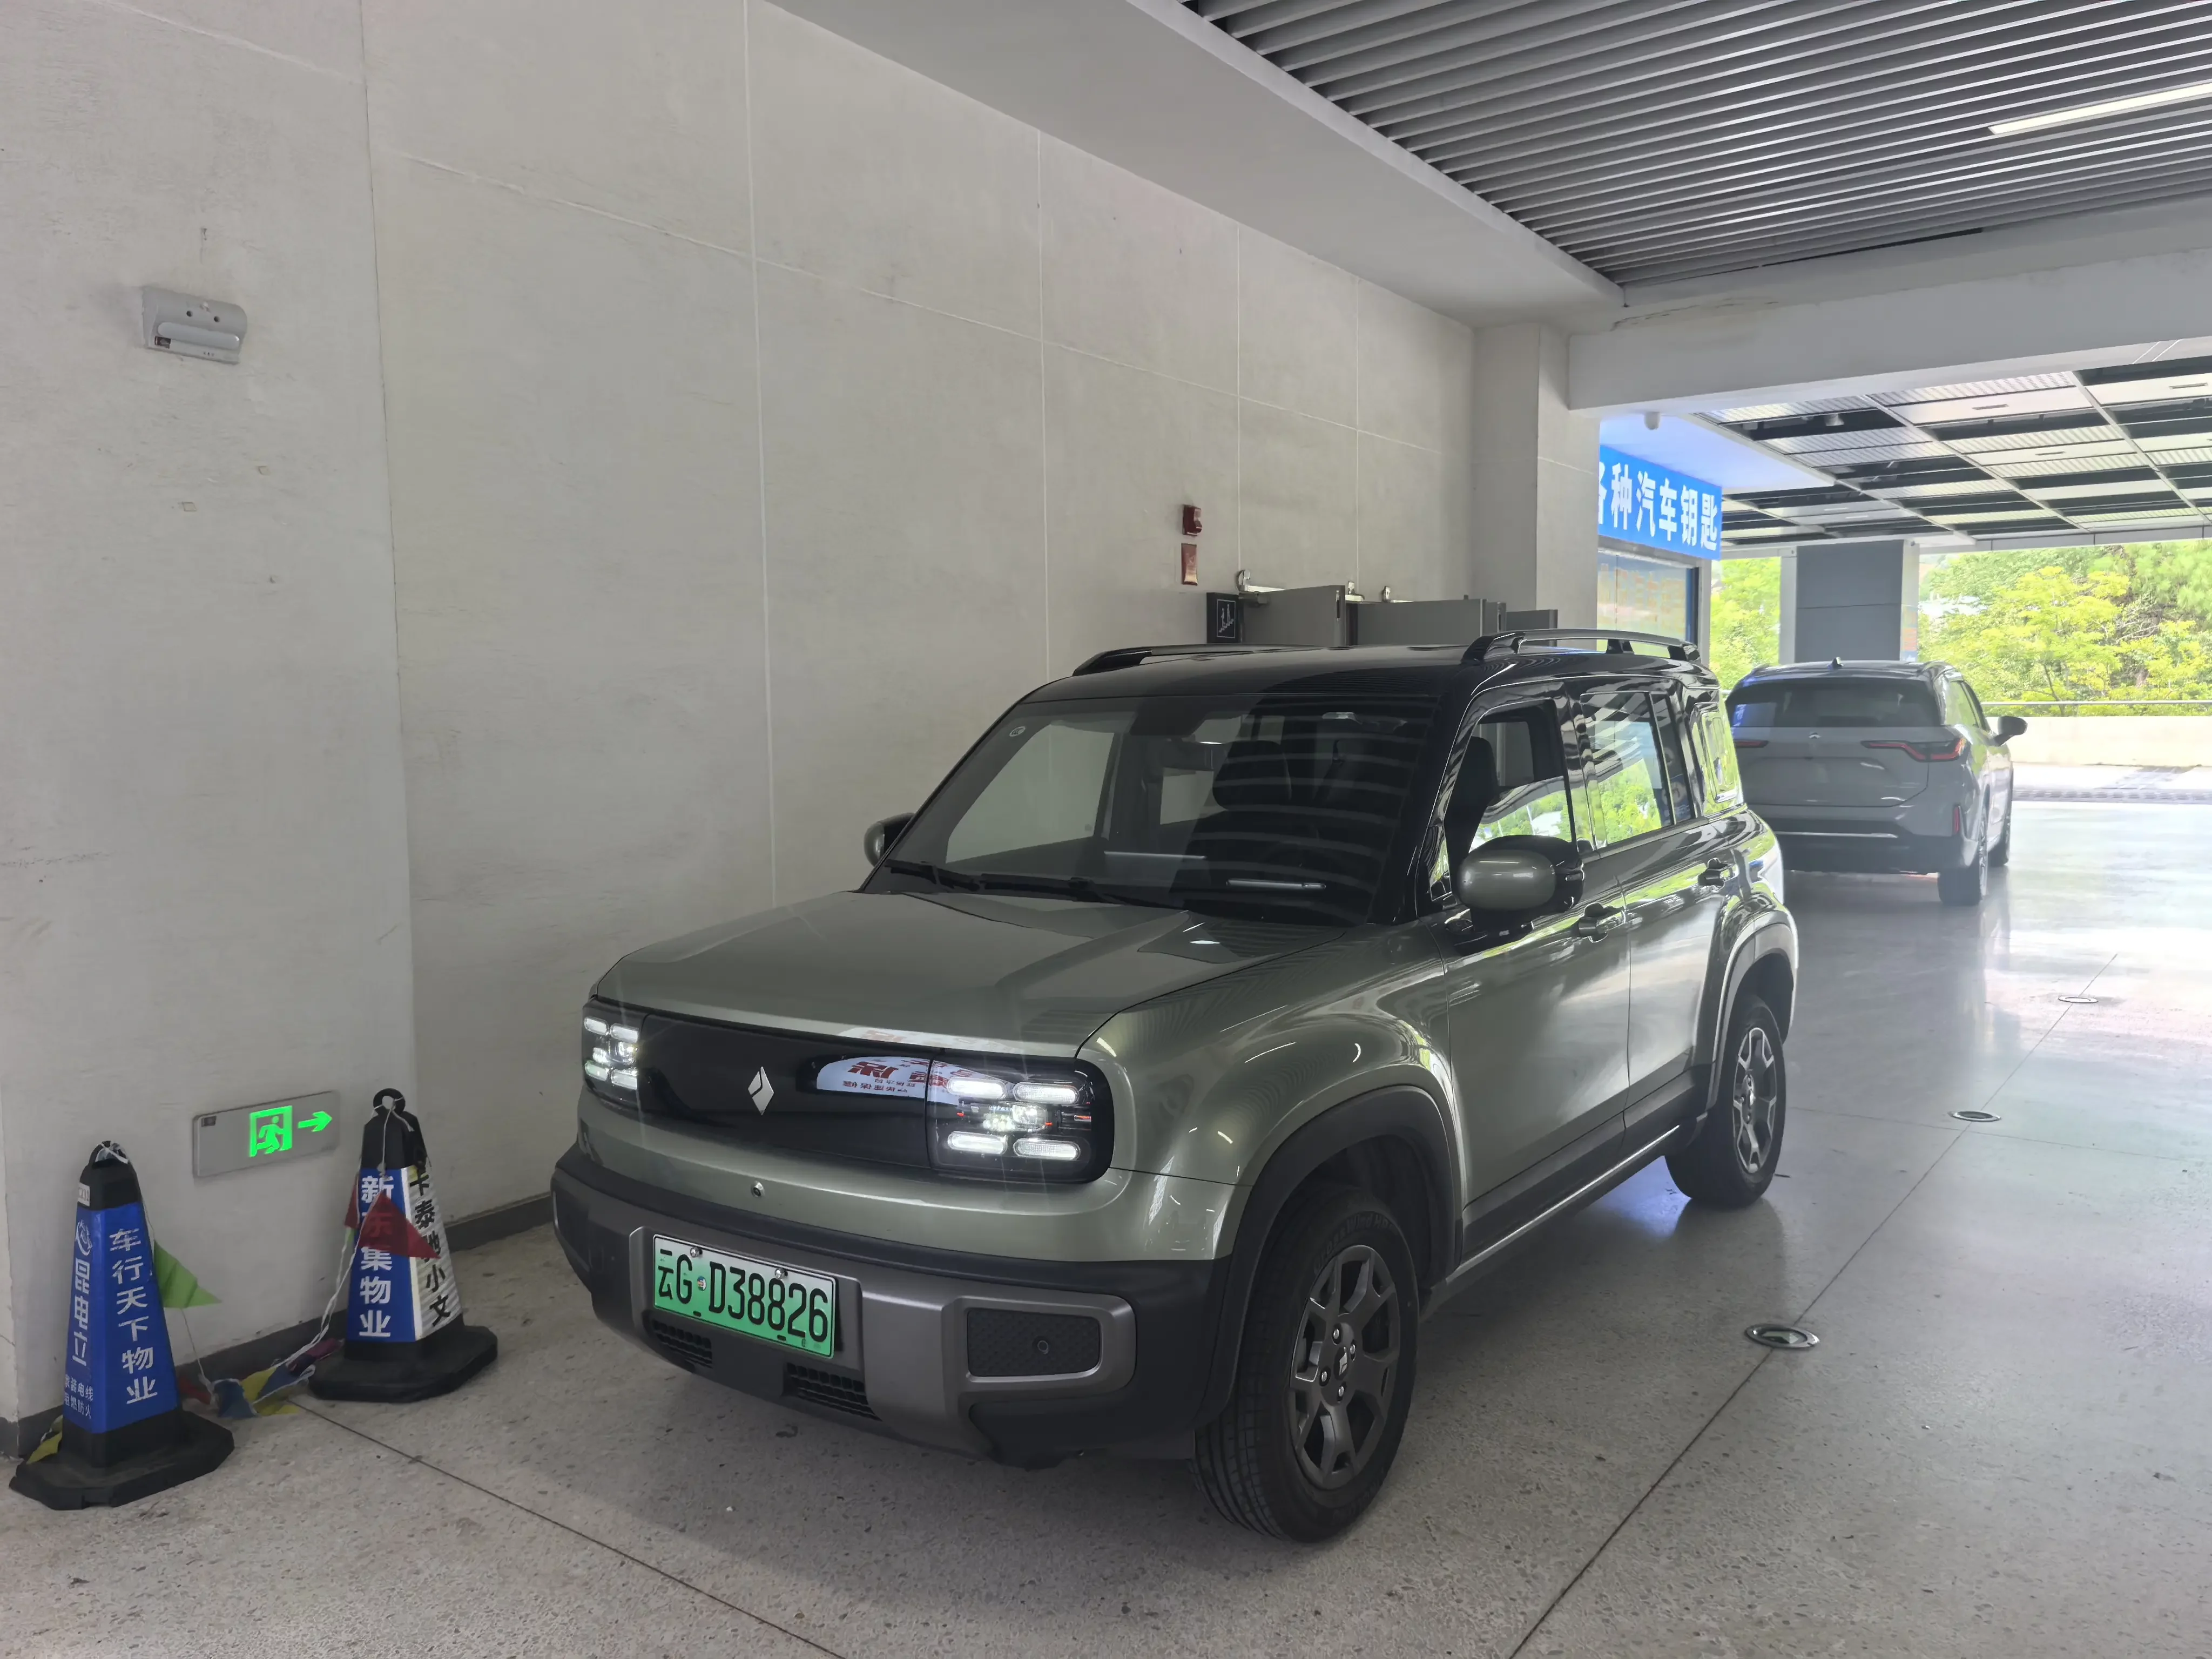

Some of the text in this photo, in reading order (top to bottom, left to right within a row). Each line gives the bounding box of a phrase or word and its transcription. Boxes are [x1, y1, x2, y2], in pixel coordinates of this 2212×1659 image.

[109, 1228, 158, 1404] 车行天下物业
[708, 1260, 828, 1343] D38826
